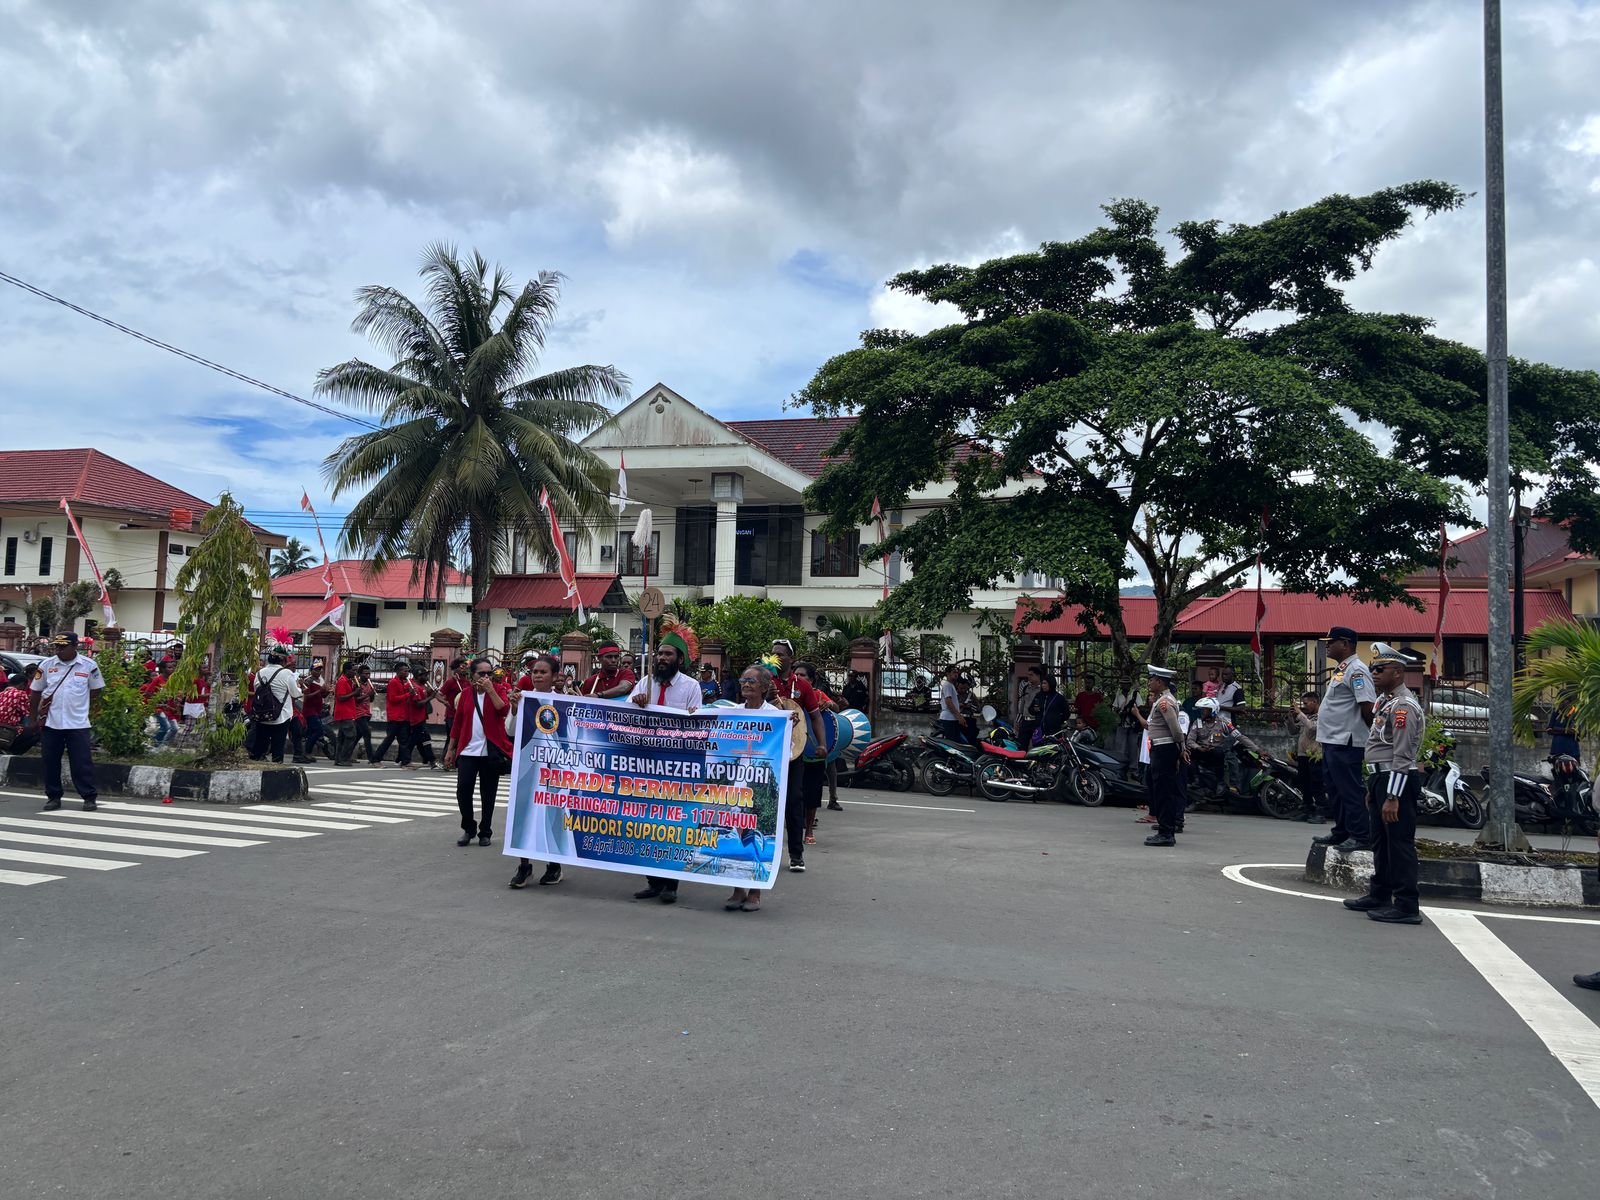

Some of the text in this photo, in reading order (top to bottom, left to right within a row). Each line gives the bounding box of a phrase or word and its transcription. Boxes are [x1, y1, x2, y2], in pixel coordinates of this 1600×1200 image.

[643, 592, 660, 612] 24
[566, 708, 772, 732] GEREJA KRISTEN INJILI DI TANAH PAPUA
[608, 733, 718, 751] KLASIS SUPIORI UTARA
[719, 733, 763, 741] Indonesia)
[530, 746, 770, 784] JEMAAT GKI EBENHAEZER KPUDORI
[539, 767, 754, 808] PARADE BERMAZMUR
[534, 791, 757, 829] MEMPERINGATI HUT PI KE- 117 TAHUN
[563, 814, 719, 848] MAUDORI SUPIORI BIAK
[582, 836, 594, 850] 26
[594, 838, 613, 855] April
[615, 840, 635, 855] 1908
[640, 844, 651, 857] 26
[652, 846, 672, 862] April
[674, 848, 695, 863] 2025
